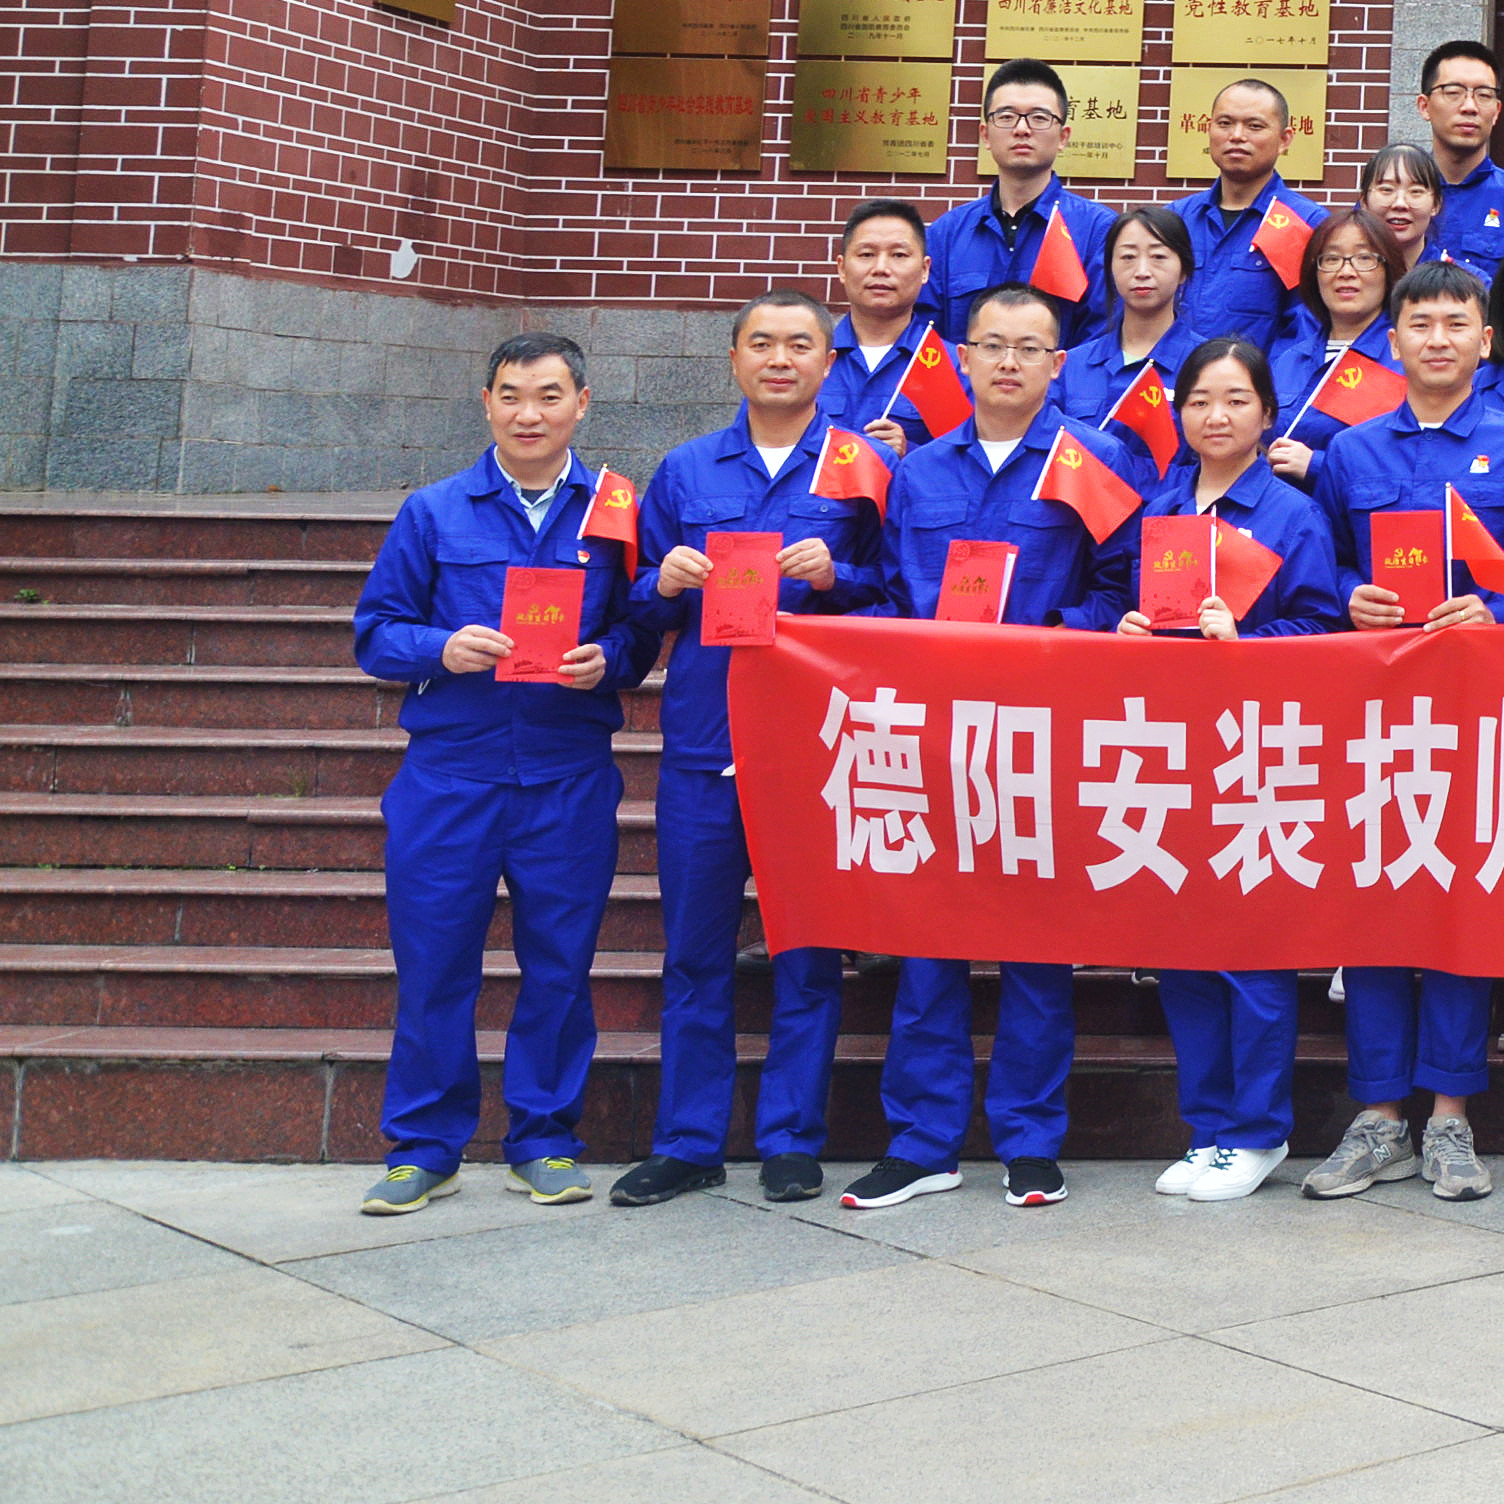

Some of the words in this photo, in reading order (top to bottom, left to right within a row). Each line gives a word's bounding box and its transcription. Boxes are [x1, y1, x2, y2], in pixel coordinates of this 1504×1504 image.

[822, 86, 922, 104] 四川省青少年
[803, 108, 938, 126] 爱国主义教育基地
